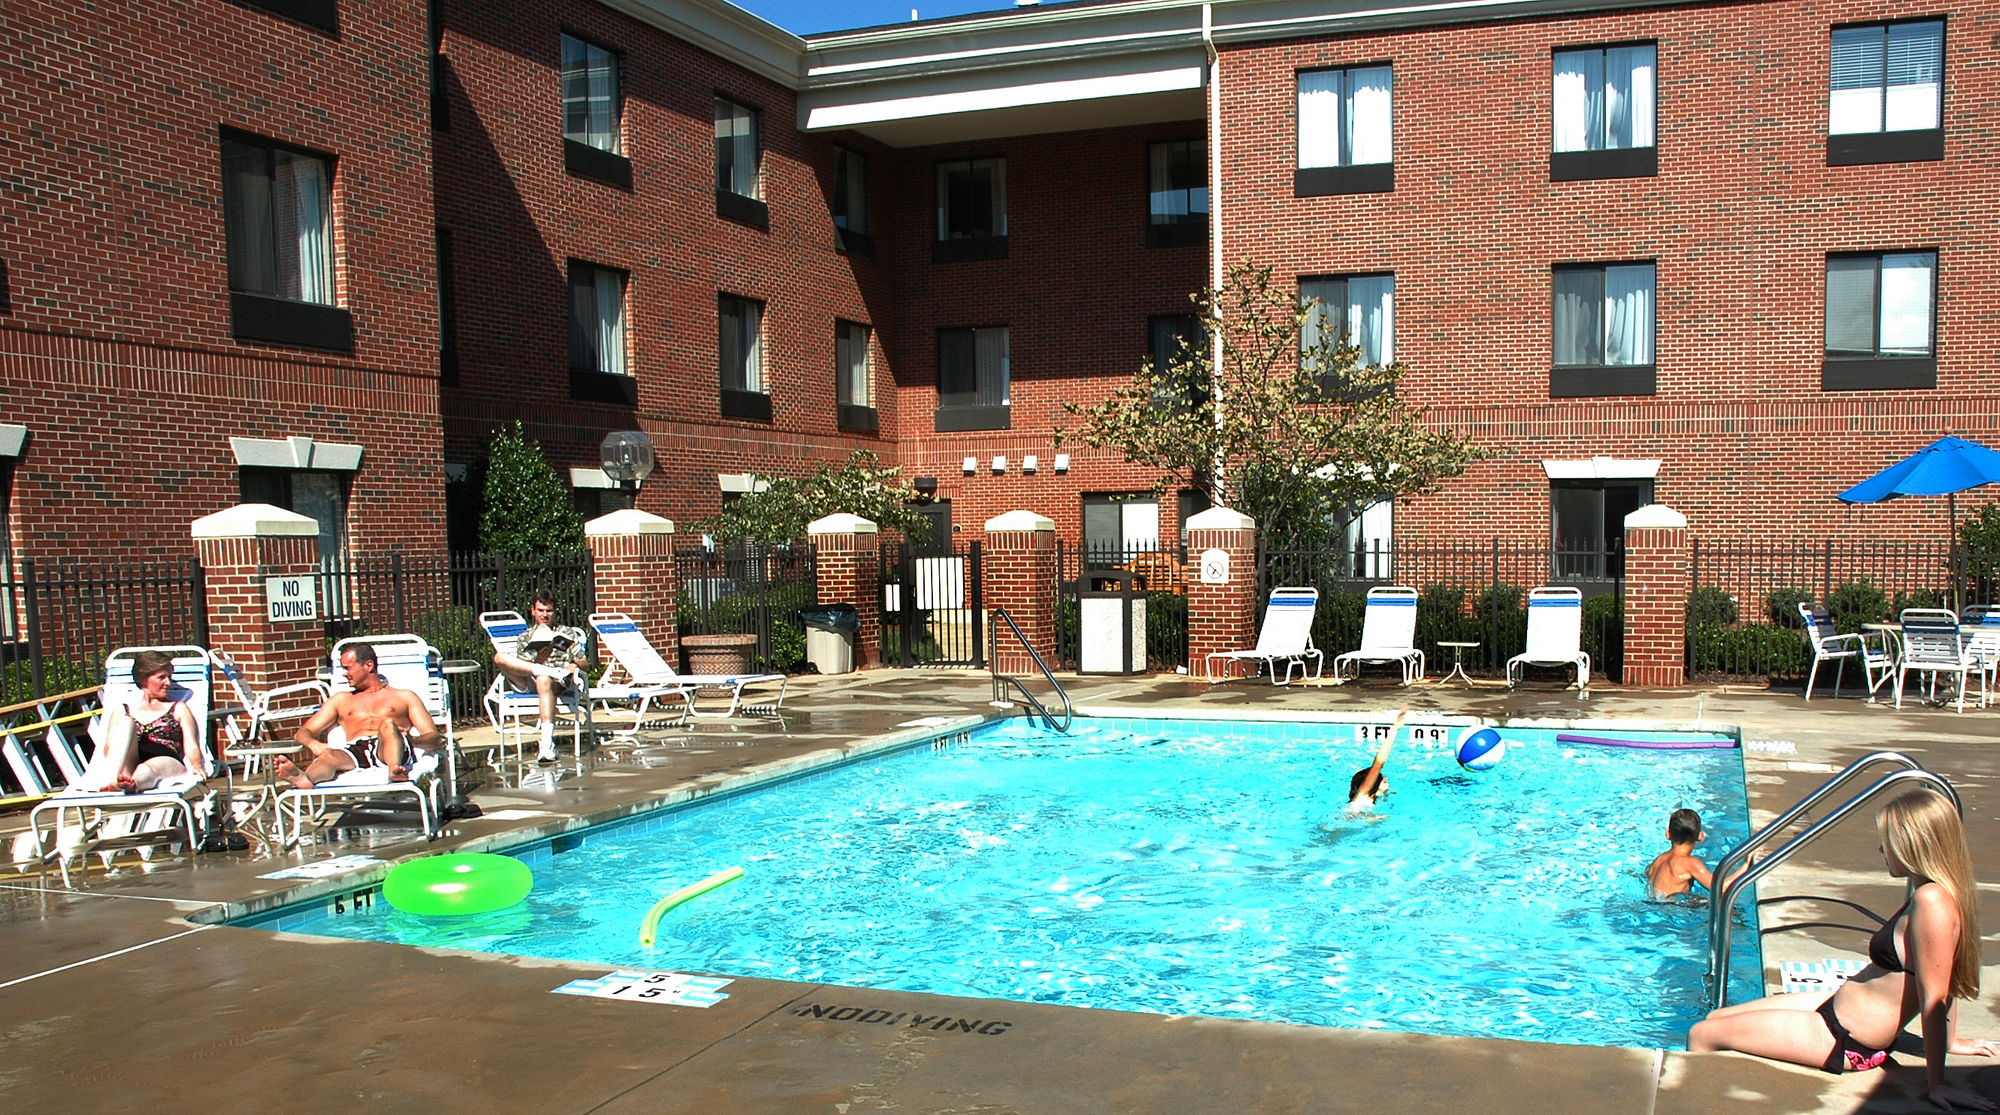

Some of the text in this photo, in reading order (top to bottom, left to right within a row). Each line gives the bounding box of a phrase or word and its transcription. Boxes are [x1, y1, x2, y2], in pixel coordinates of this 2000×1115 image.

[283, 580, 299, 596] NO
[272, 600, 312, 617] DIVING
[1361, 726, 1391, 739] 3 FT
[353, 887, 373, 909] FT
[644, 974, 671, 983] 5
